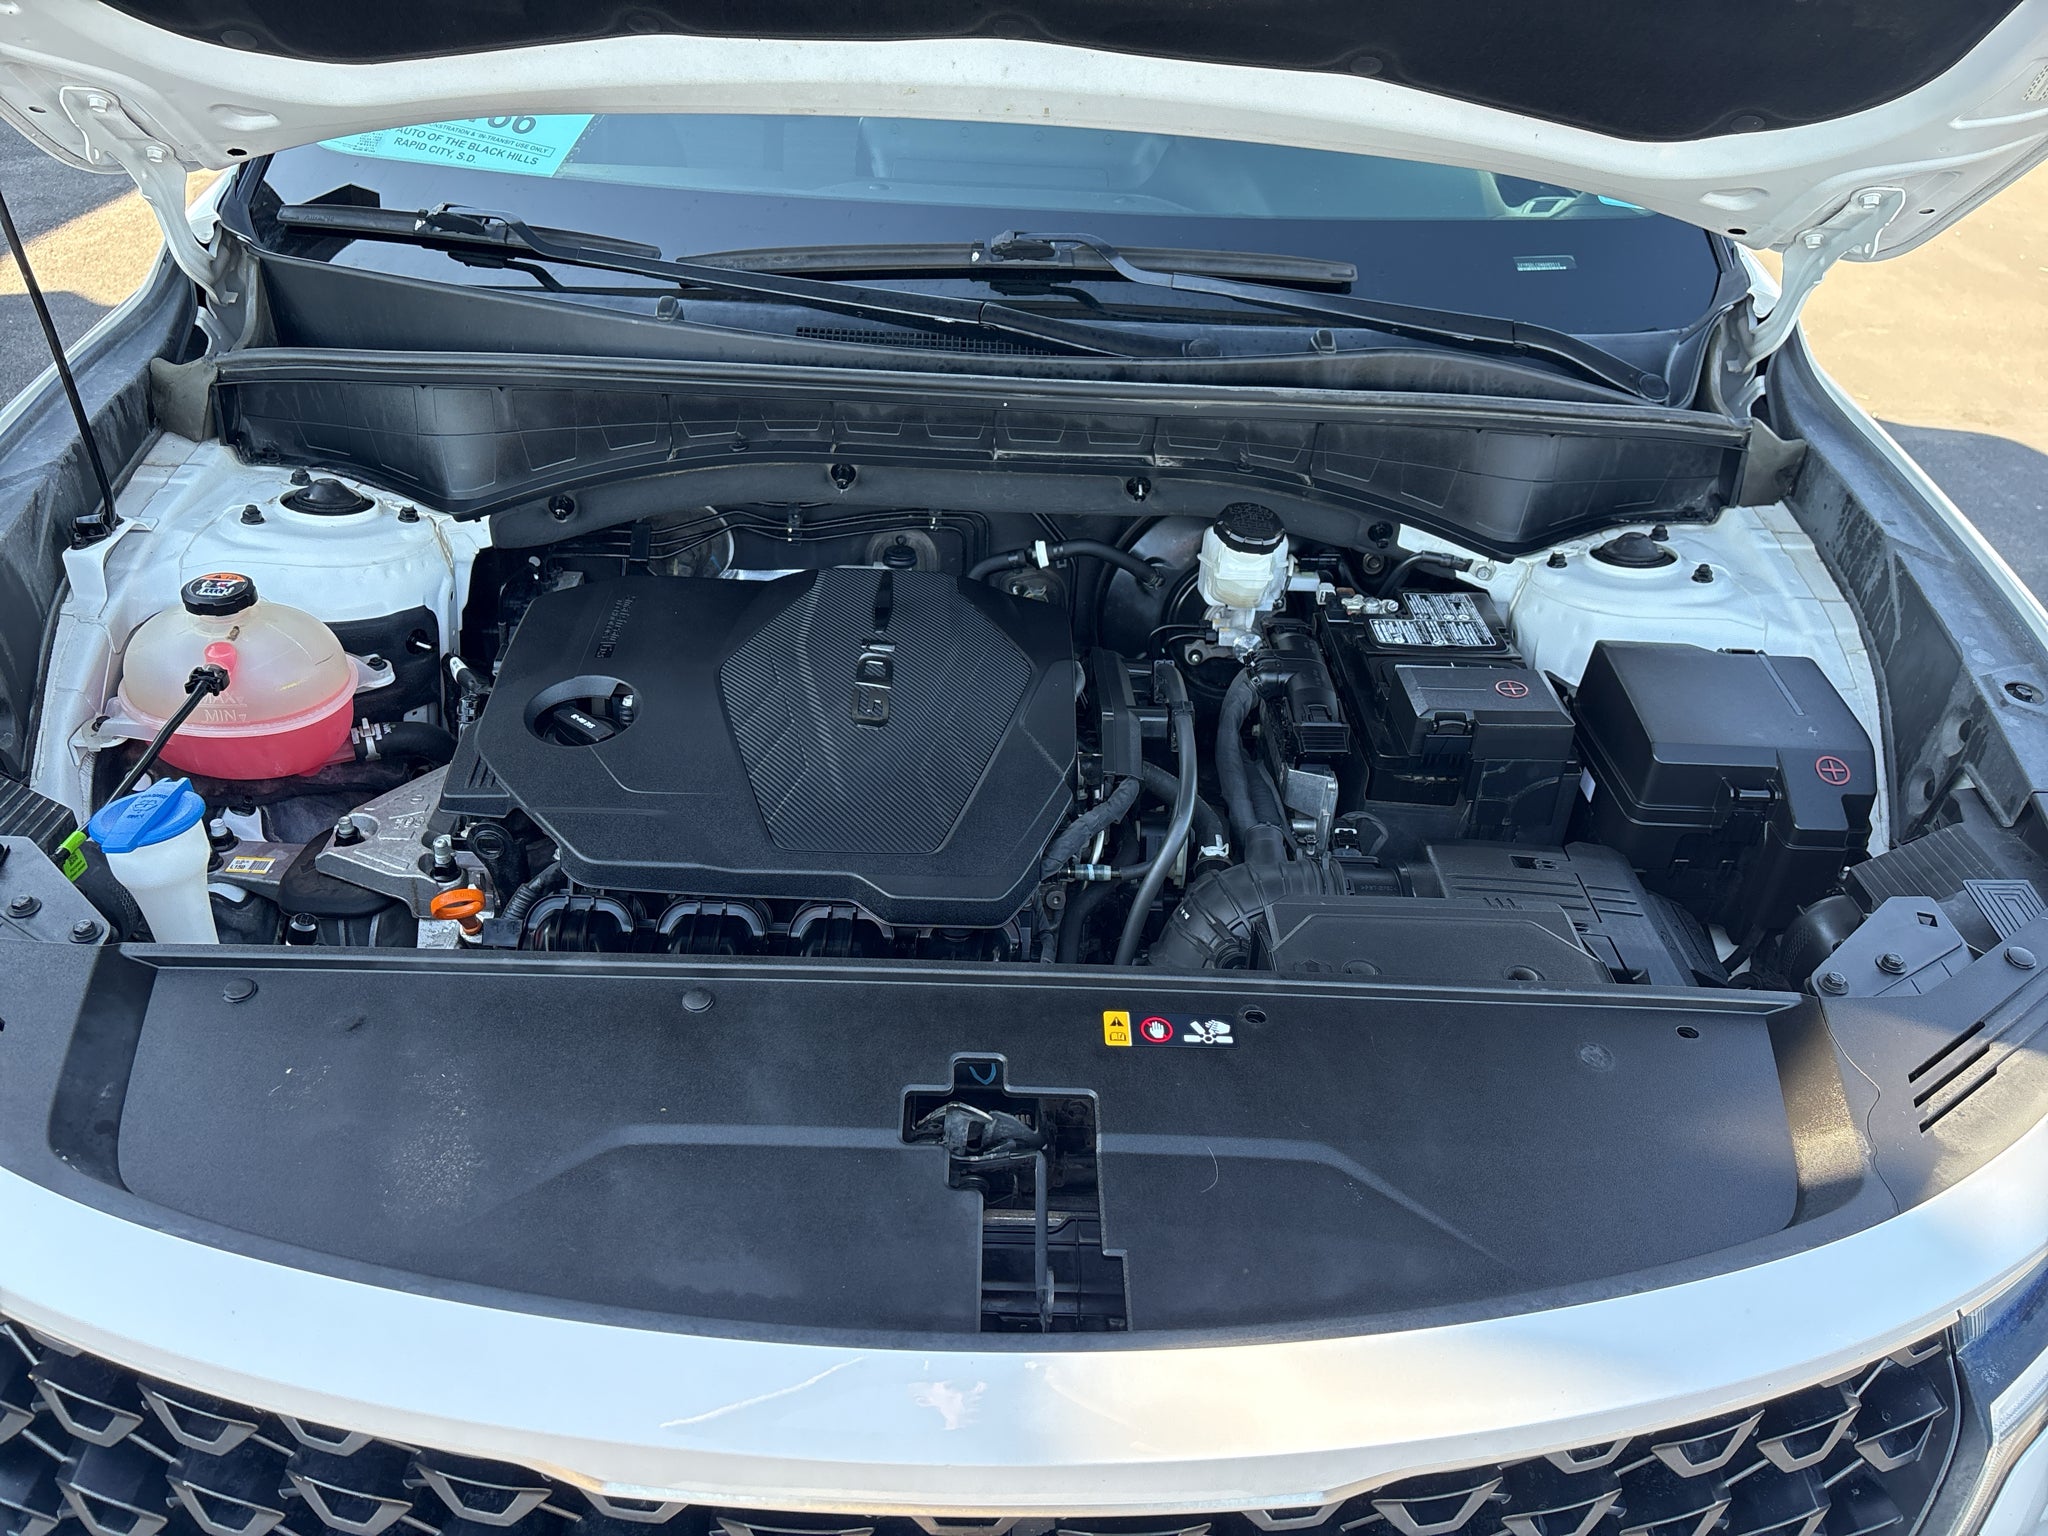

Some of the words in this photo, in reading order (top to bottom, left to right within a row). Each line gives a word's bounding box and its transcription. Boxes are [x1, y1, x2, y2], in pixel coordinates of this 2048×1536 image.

[394, 137, 427, 151] RAPID
[428, 145, 455, 159] CITY,
[456, 151, 477, 164] S.D.
[396, 127, 426, 138] AUTO
[427, 133, 444, 142] OF
[445, 136, 467, 149] THE
[467, 142, 506, 158] BLACK
[506, 151, 540, 165] HILLS
[515, 141, 529, 150] USE
[529, 145, 549, 154] ONLY
[204, 709, 238, 722] MIN
